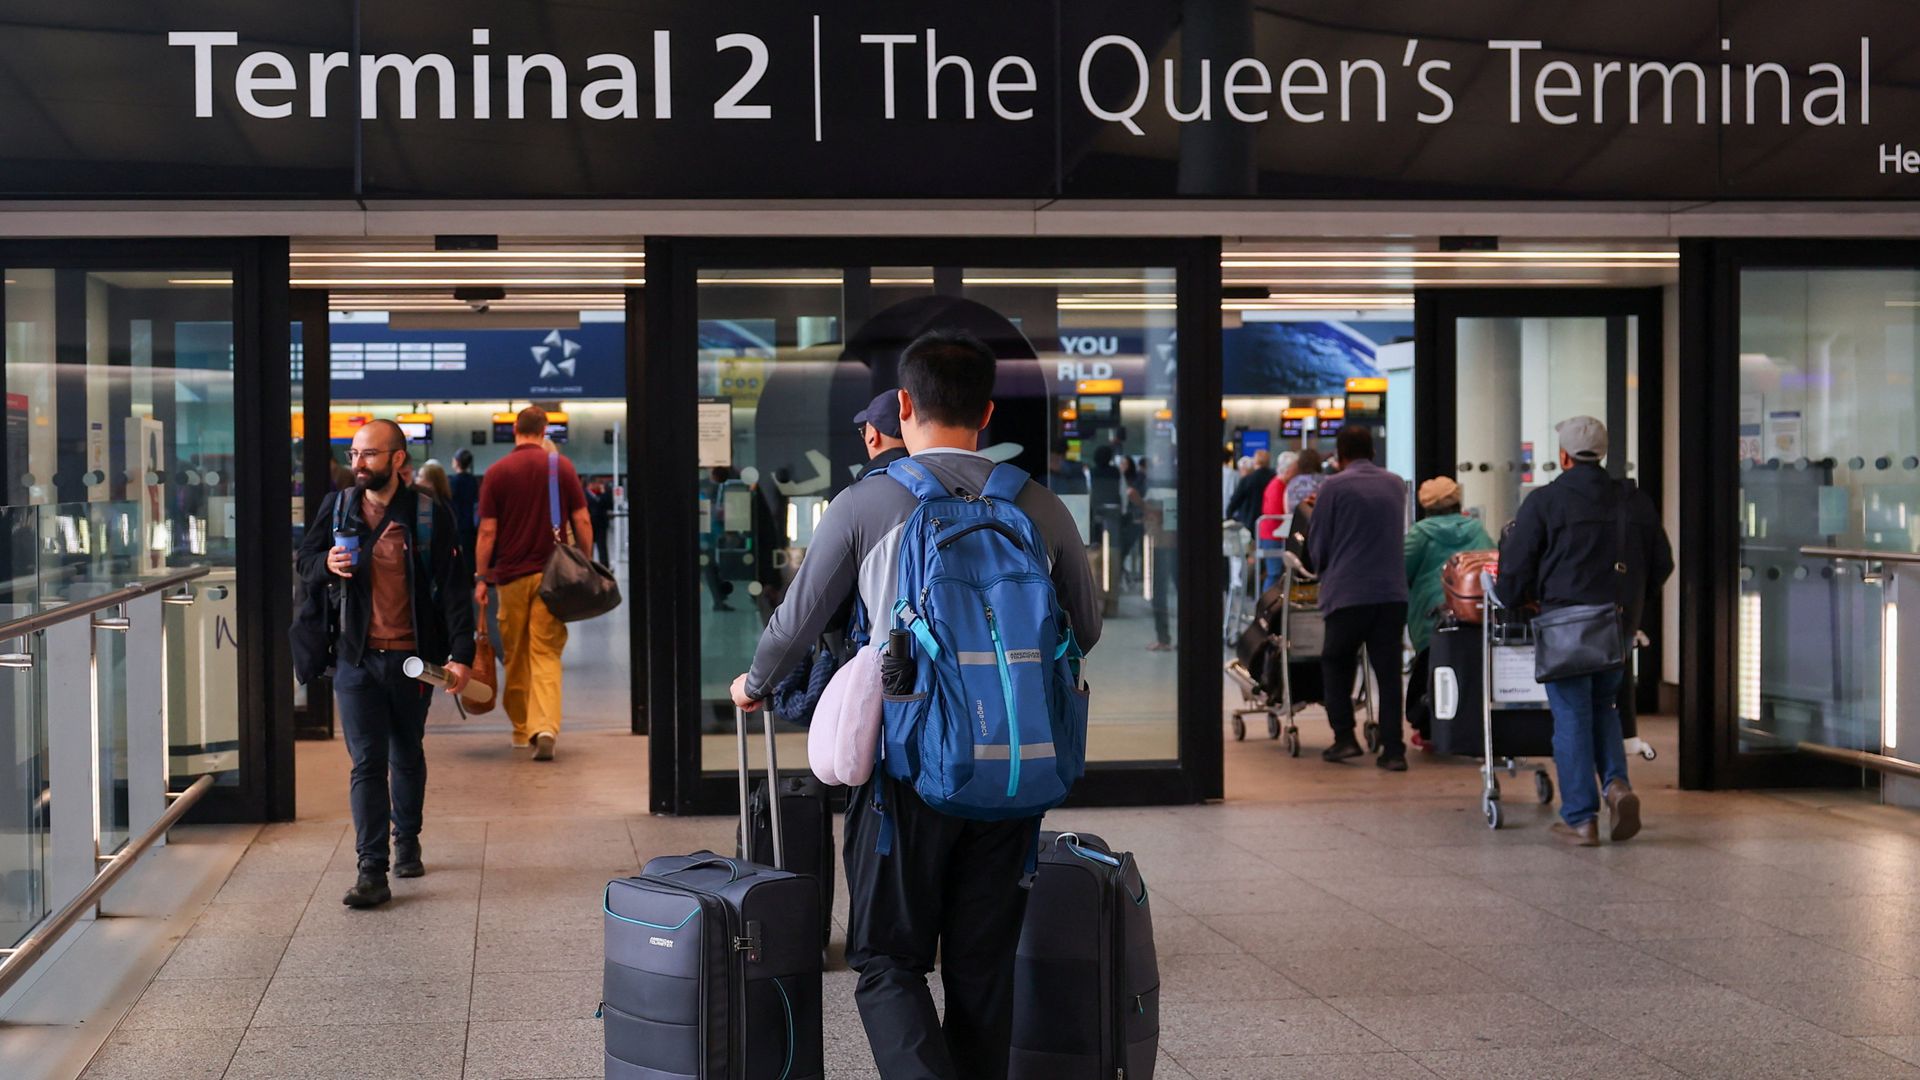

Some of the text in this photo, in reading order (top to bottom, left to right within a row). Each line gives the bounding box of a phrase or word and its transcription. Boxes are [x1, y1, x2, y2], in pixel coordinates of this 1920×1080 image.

[168, 28, 672, 120] Terminal
[713, 33, 772, 119] 2
[860, 28, 1037, 122] The
[1488, 37, 1869, 126] Terminal
[1879, 143, 1920, 173] He
[1059, 336, 1119, 355] YOU
